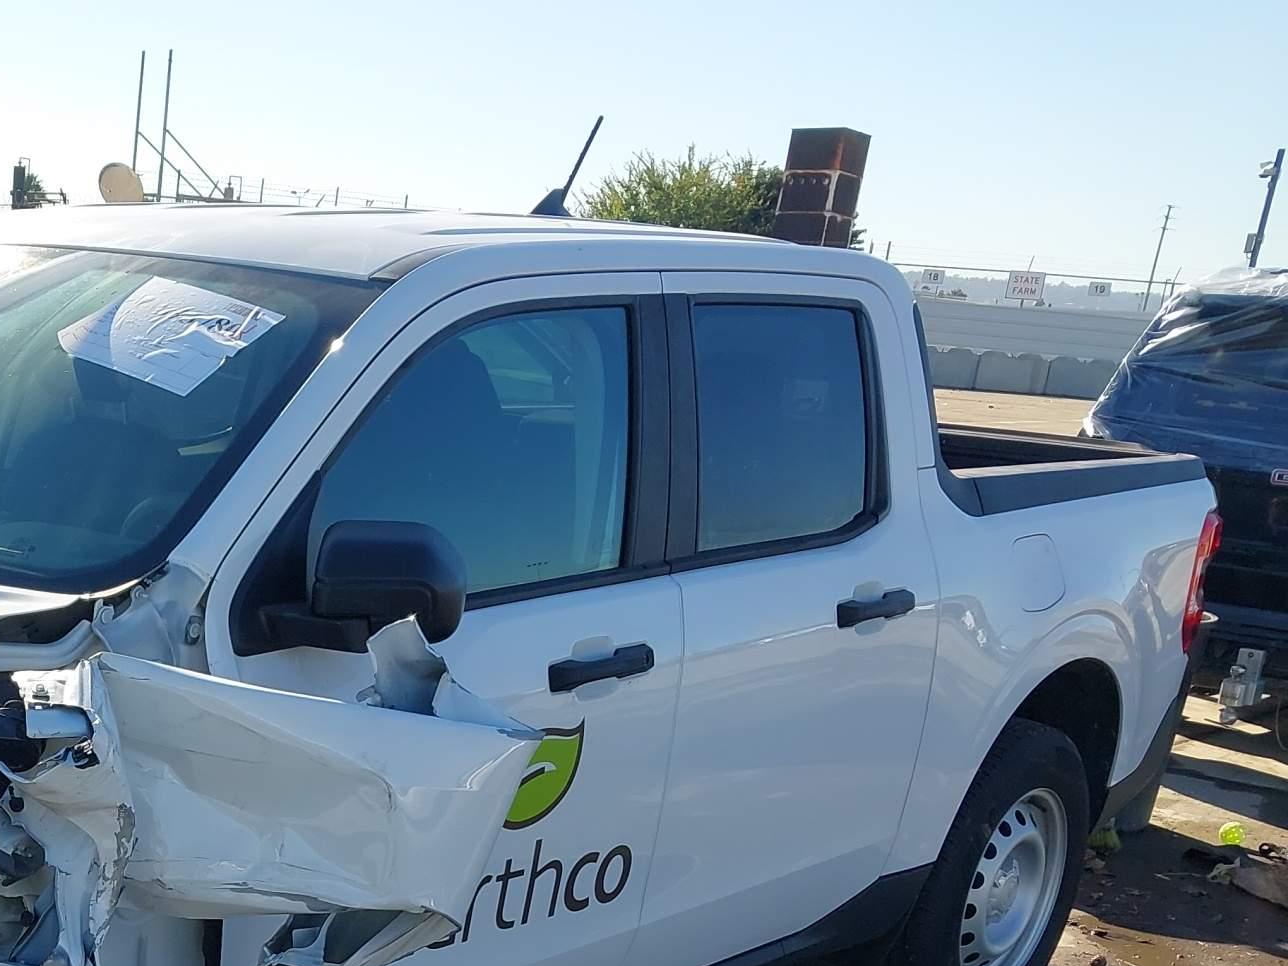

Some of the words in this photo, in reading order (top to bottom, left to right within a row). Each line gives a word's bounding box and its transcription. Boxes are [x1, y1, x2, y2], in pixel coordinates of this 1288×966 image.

[927, 271, 939, 281] 18
[1013, 275, 1040, 285] STATE
[1011, 287, 1037, 296] FARM
[1094, 285, 1105, 294] 19
